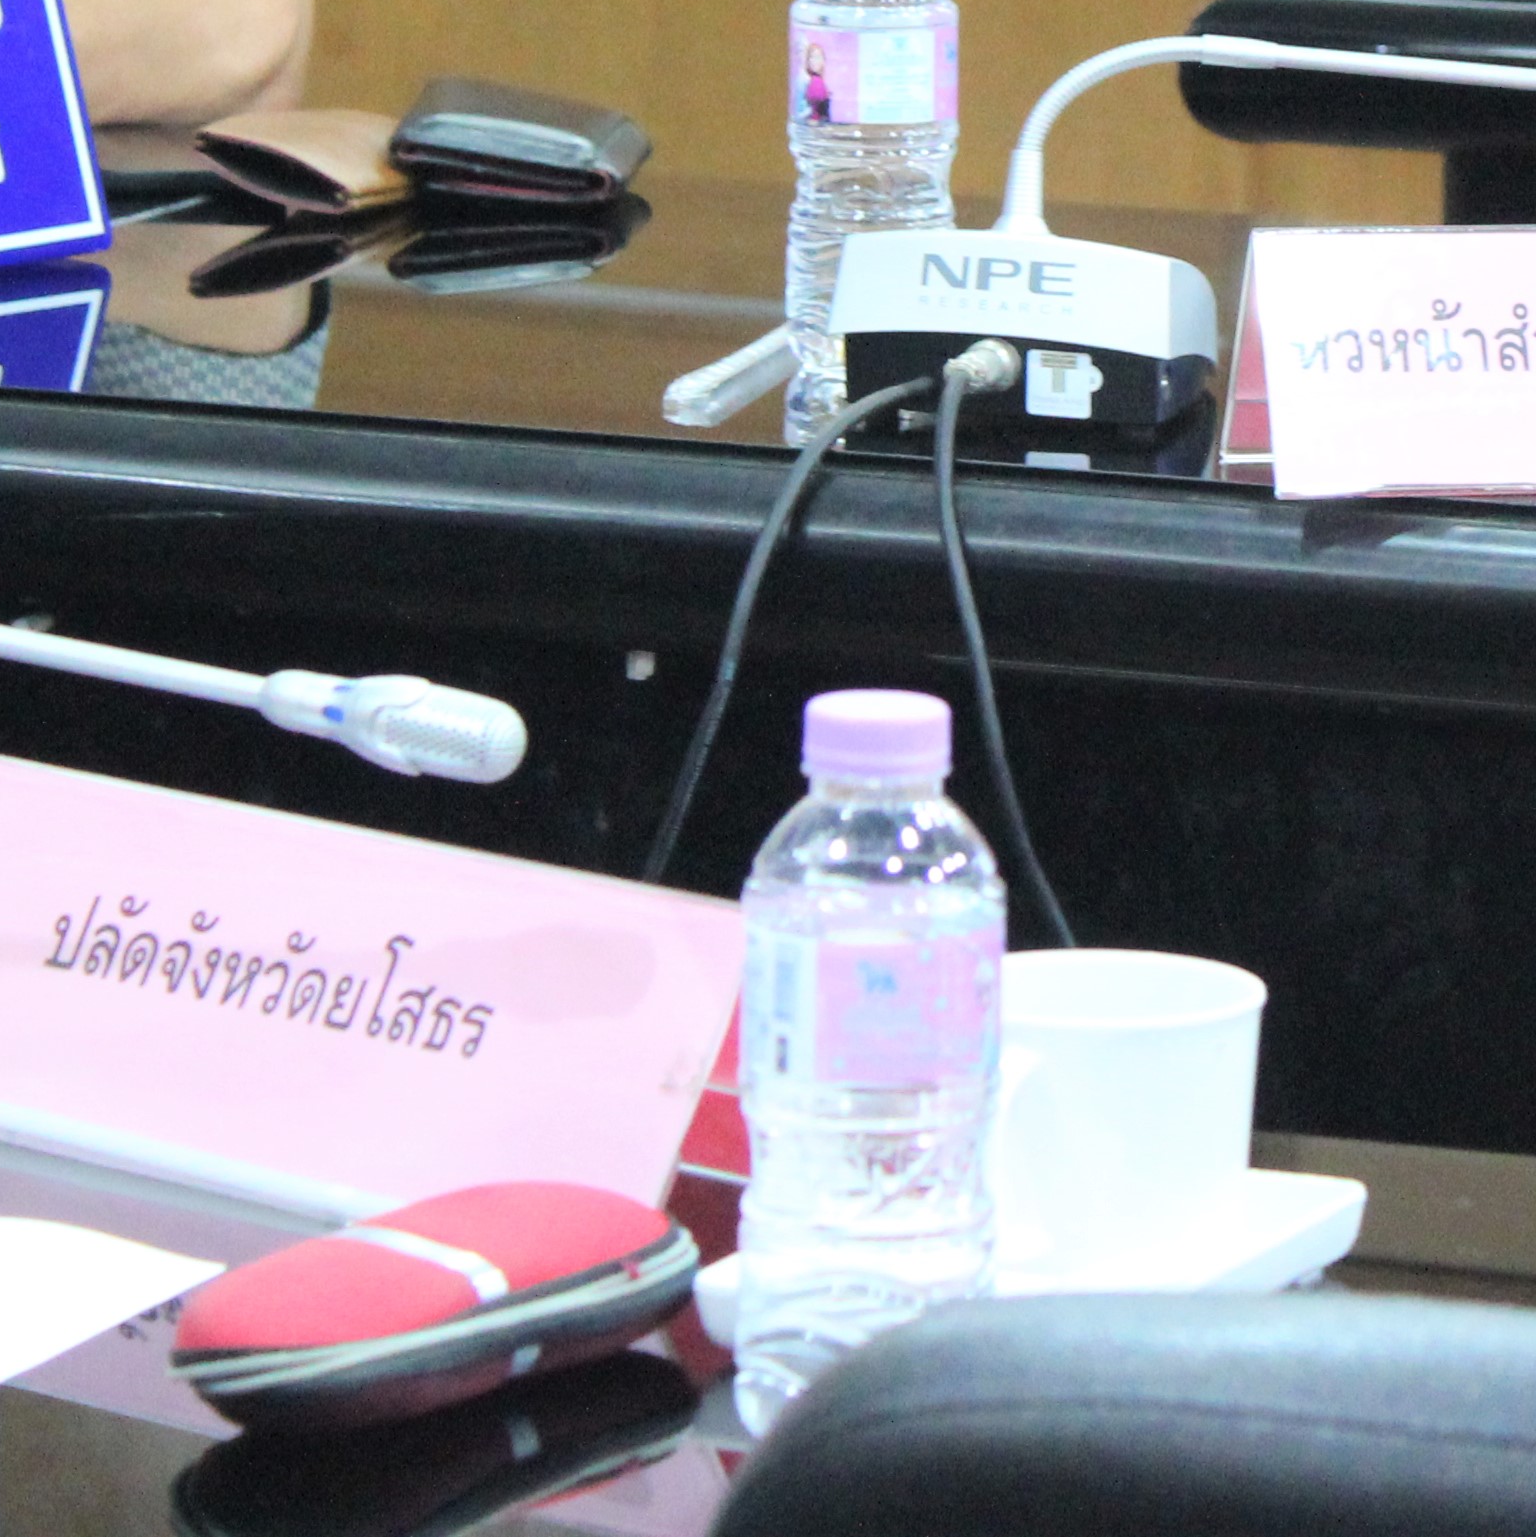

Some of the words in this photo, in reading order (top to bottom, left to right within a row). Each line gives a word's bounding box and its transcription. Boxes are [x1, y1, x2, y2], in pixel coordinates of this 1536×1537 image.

[921, 252, 1077, 298] NPE
[917, 294, 1074, 315] RESEARCH
[44, 895, 495, 1058] ปลัดจังหวัดยโสธร
